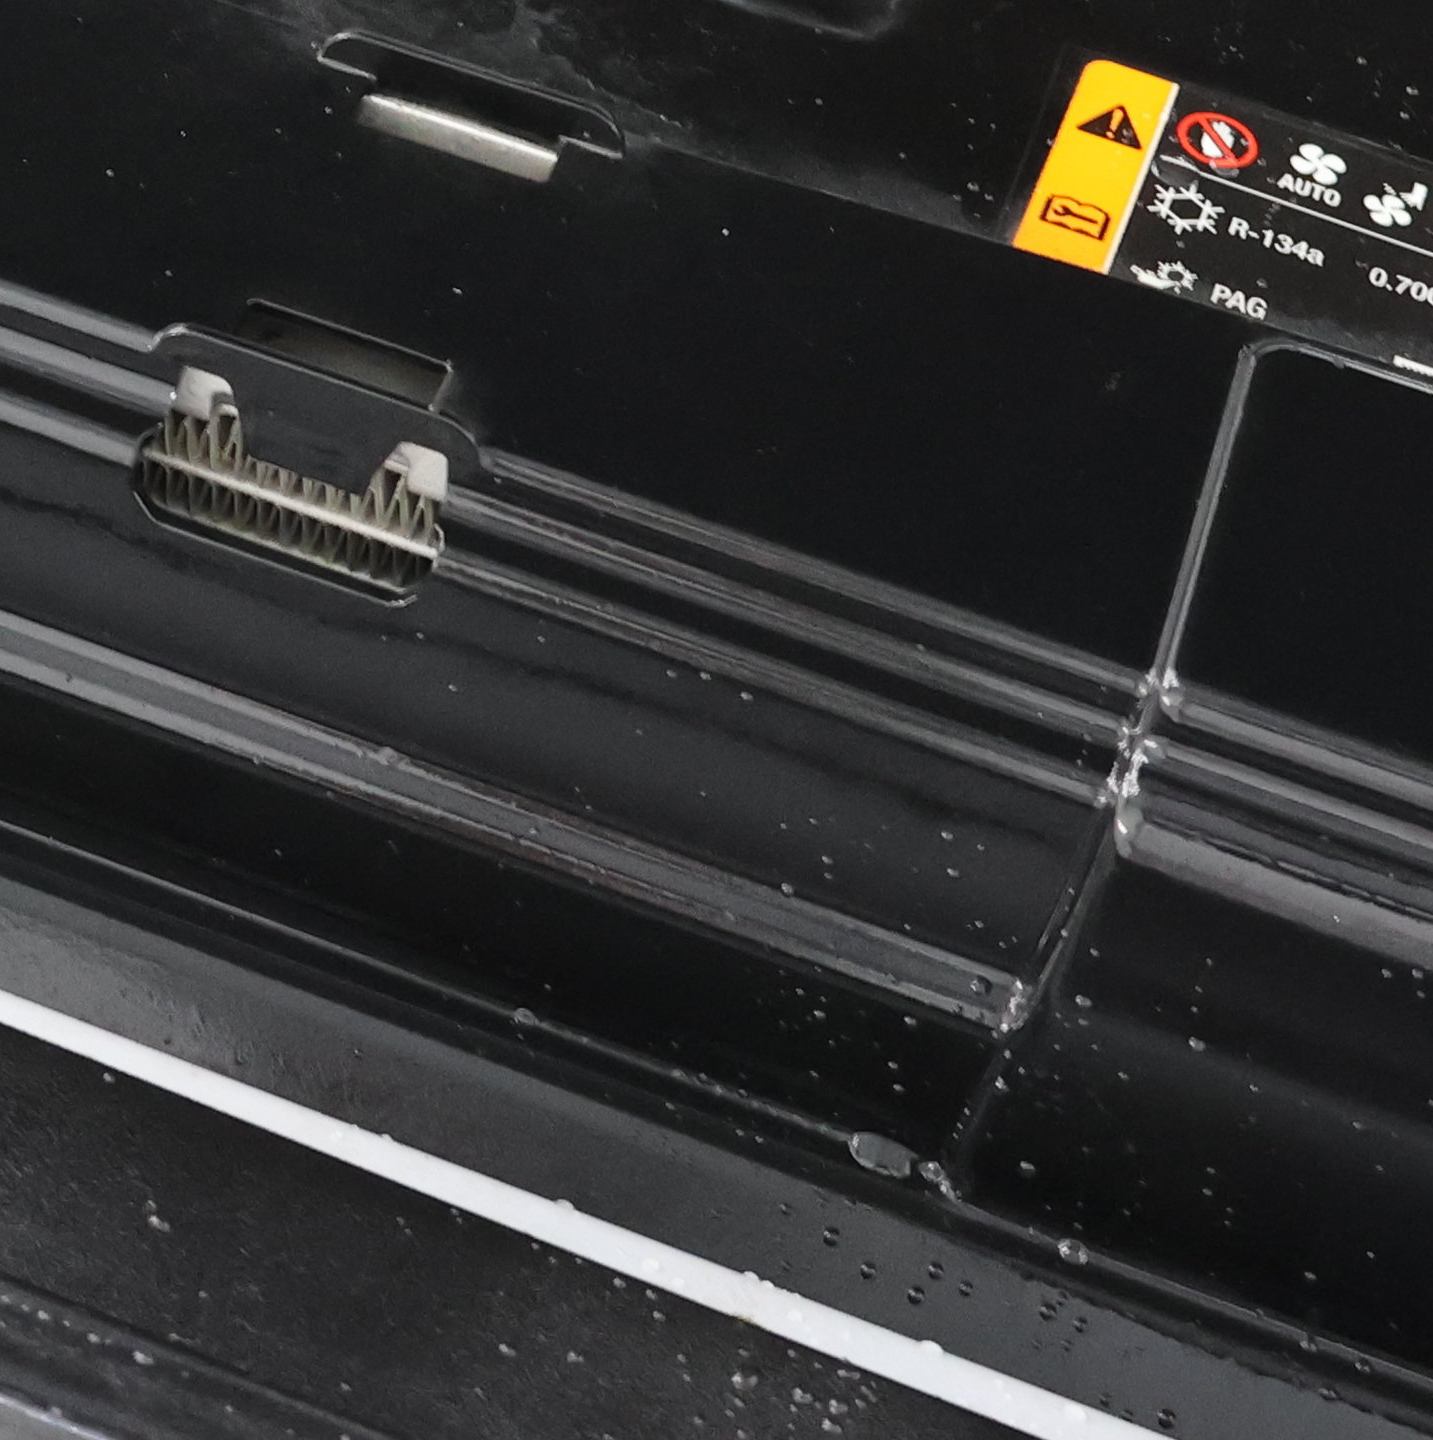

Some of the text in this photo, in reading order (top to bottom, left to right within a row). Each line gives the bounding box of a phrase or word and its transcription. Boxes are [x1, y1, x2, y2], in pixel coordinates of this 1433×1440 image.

[1277, 171, 1342, 208] AUTO
[1228, 216, 1325, 268] R-134a
[1211, 282, 1268, 321] PAG
